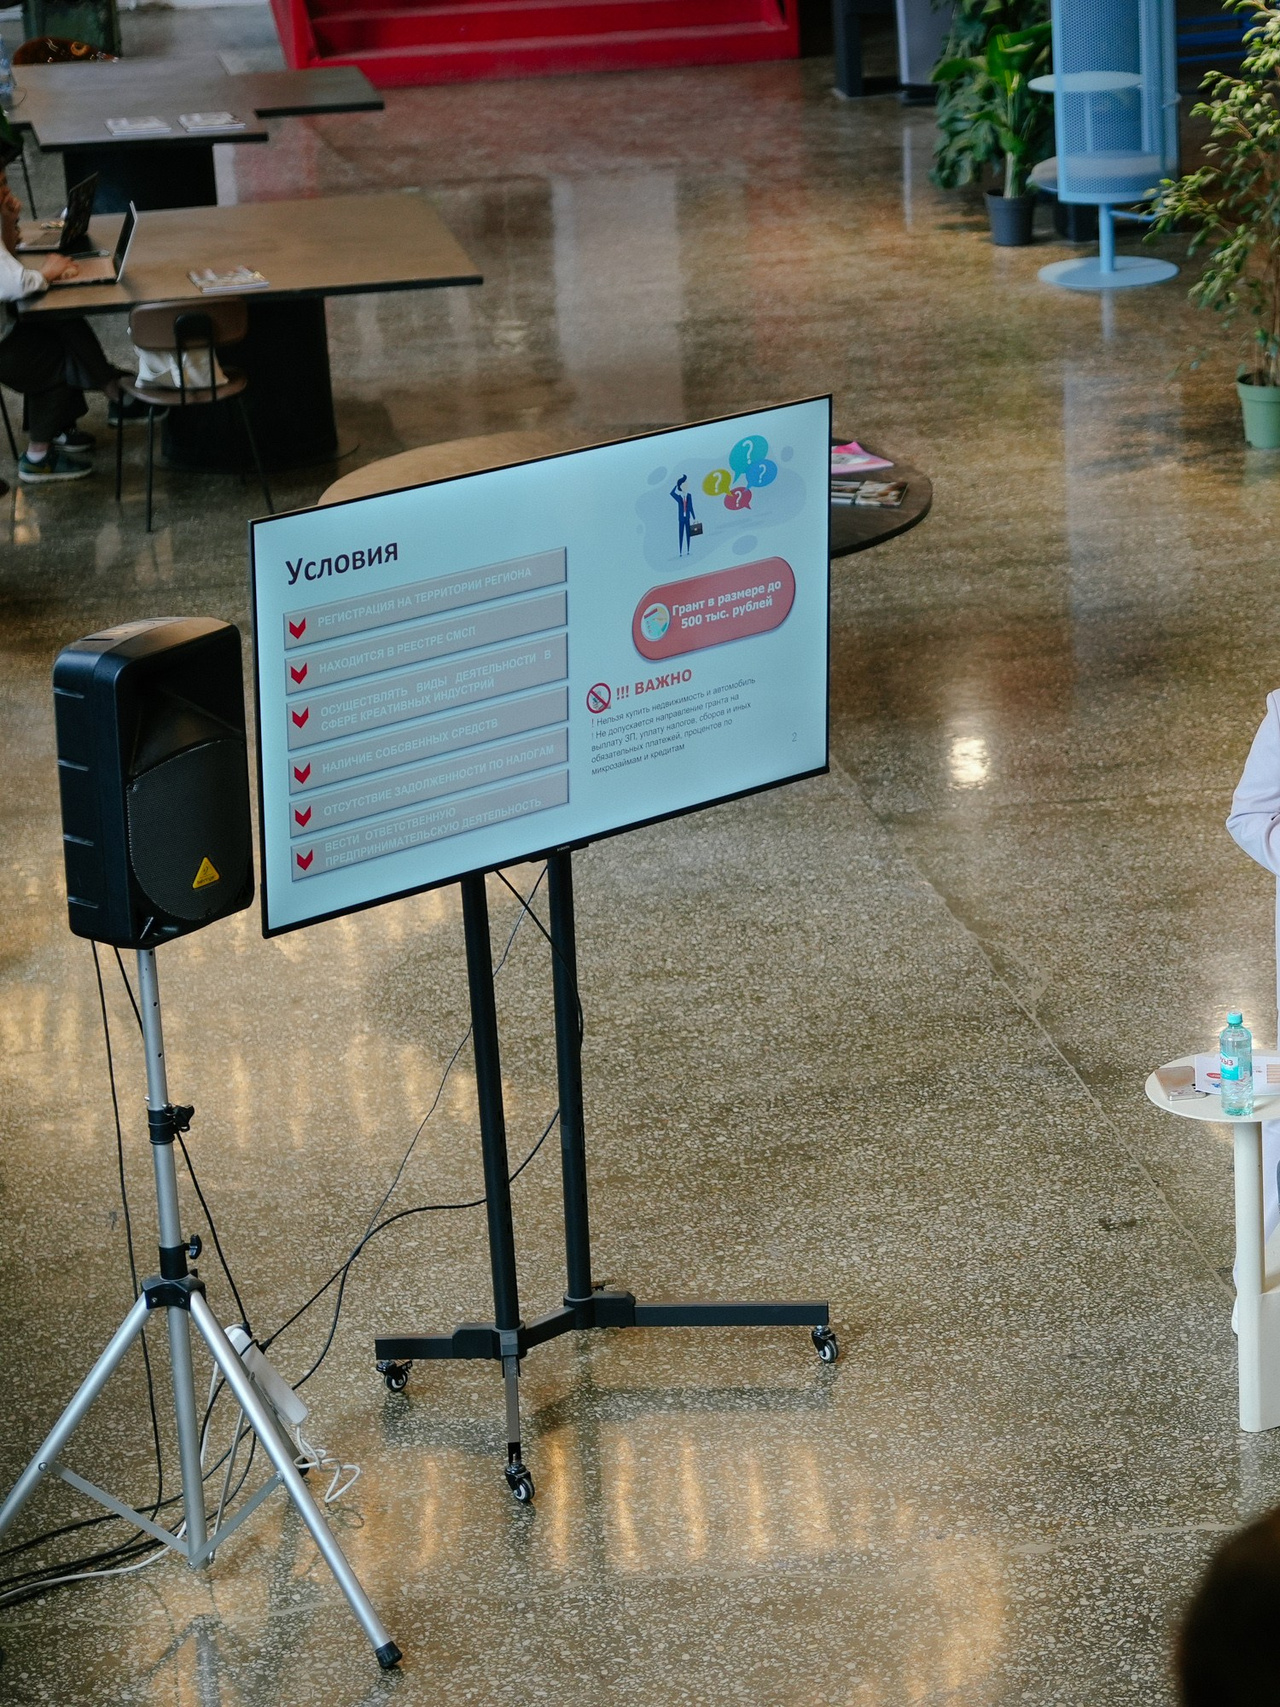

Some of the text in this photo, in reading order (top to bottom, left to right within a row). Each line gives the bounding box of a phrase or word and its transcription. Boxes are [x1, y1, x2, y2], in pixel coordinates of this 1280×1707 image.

[285, 542, 398, 585] Условия
[318, 567, 532, 627] РЕГИСТРАЦИЯ НА ТЕРРИТОРИИ РЕГИОНА
[672, 580, 782, 616] Грант в размере до
[681, 594, 773, 629] 500 тыс. рублей
[319, 626, 476, 673] НАХОДИТСЯ В РЕЕСТРЕ СМСП
[321, 649, 552, 717] ОСУЩЕСТВЛЯТЬ ВИДЫ ДЕЯТЕЛЬНОСТИ В
[321, 676, 495, 732] СФЕРЕ КРЕАТИВНЫХ ИНДУСТРИЙ
[596, 713, 624, 727] Нельзя
[625, 707, 650, 721] купить
[651, 692, 705, 711] недвижимость
[712, 678, 756, 694] автомобиль
[616, 669, 692, 700] !!! ВАЖНО
[591, 737, 622, 752] выплату
[640, 726, 664, 740] уплату
[699, 708, 724, 722] сборов
[733, 702, 751, 712] иных
[595, 730, 606, 739] Не
[607, 718, 654, 737] допускается
[655, 704, 703, 722] направление
[705, 696, 729, 709] гранта
[730, 694, 739, 702] на
[791, 731, 798, 743] 2
[322, 718, 498, 774] НАЛИЧИЕ СОБСВЕННЫХ СРЕДСТВ
[591, 744, 644, 764] обязательных
[684, 722, 722, 739] процентов
[723, 719, 733, 727] по
[591, 756, 642, 775] микрозаймам
[650, 744, 685, 760] кредитам
[323, 744, 555, 816] ОТСУТСТВИЕ ЗАДОЛЖЕННОСТИ ПО НАЛОГАМ
[324, 807, 456, 853] ВЕСТИ ОТВЕТСТВЕННУЮ
[325, 798, 542, 867] ПРЕДПРИНИМАТЕЛЬСКУЮ ДЕЯТЕЛЬНОСТЬ
